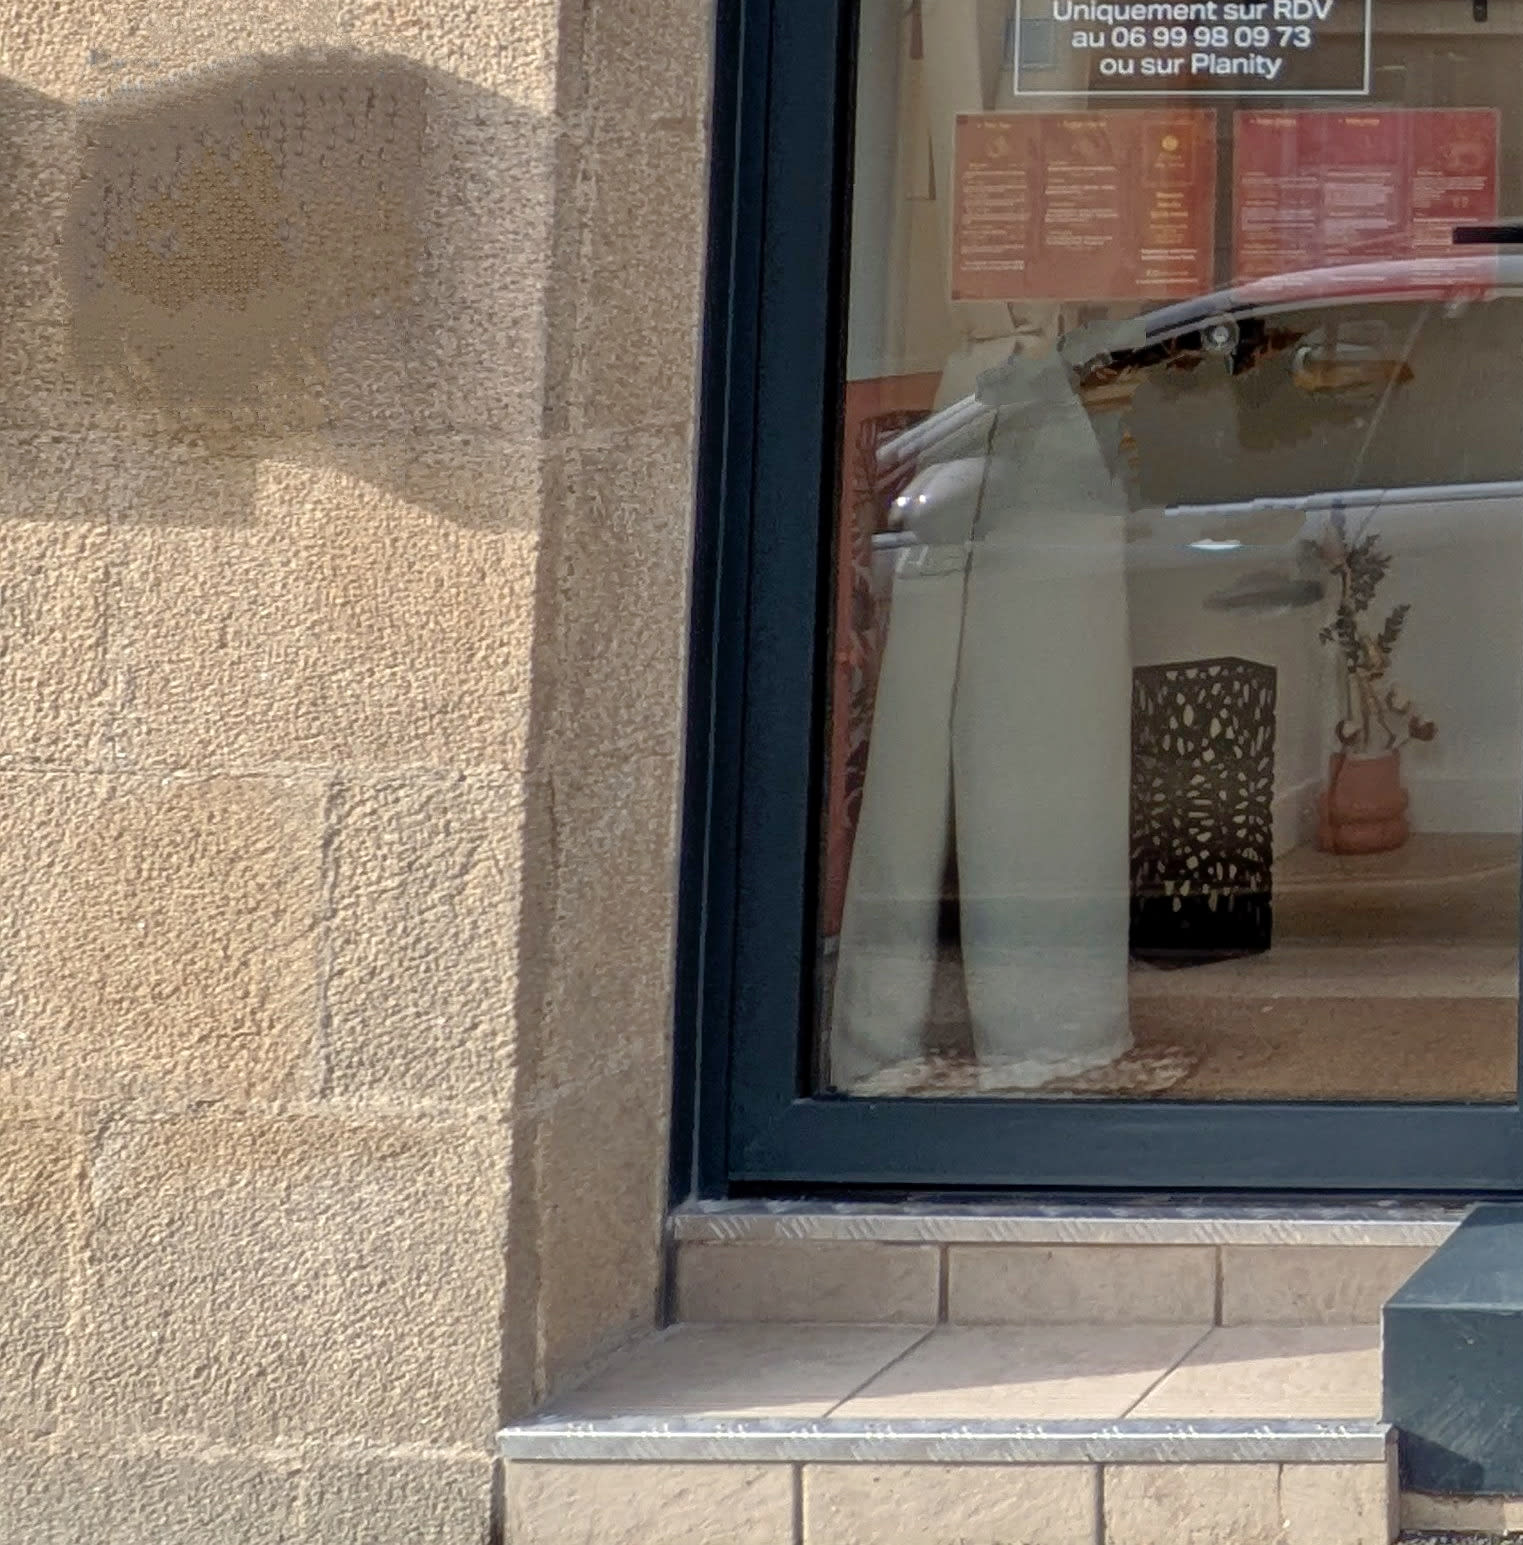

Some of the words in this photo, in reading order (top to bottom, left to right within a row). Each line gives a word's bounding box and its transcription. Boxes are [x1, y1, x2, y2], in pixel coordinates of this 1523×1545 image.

[1052, 0, 1217, 25] Uniquement
[1223, 3, 1266, 20] sur
[1071, 29, 1105, 48] au
[1111, 27, 1146, 47] 06
[1153, 27, 1187, 47] 99
[1194, 27, 1229, 47] 98
[1235, 27, 1269, 47] 09
[1276, 27, 1311, 47] 73
[1100, 59, 1135, 75] ou
[1141, 57, 1184, 75] sur
[1191, 54, 1282, 79] Planity
